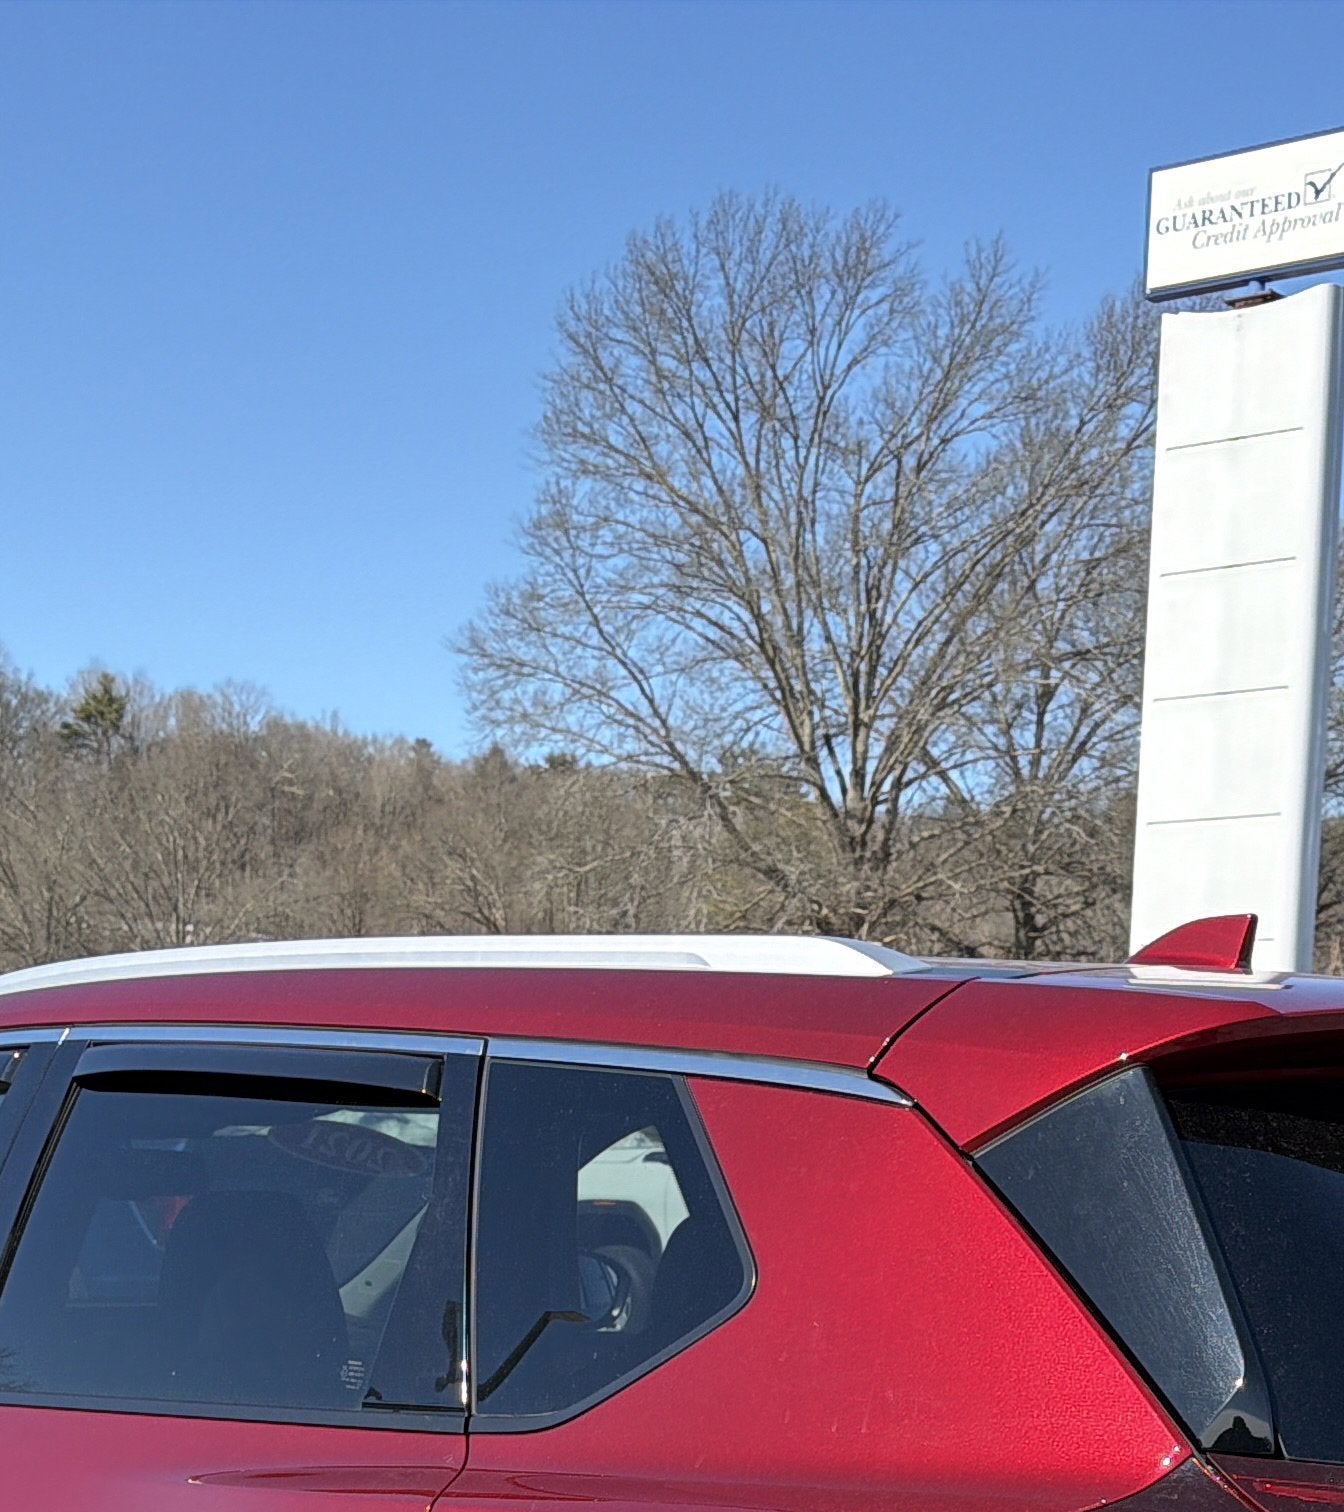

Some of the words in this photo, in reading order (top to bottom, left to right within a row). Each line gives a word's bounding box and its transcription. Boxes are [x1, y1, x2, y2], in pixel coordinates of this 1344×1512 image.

[1156, 191, 1302, 236] GUARANTEED
[1191, 223, 1249, 250] Credit
[1253, 202, 1342, 243] Approval
